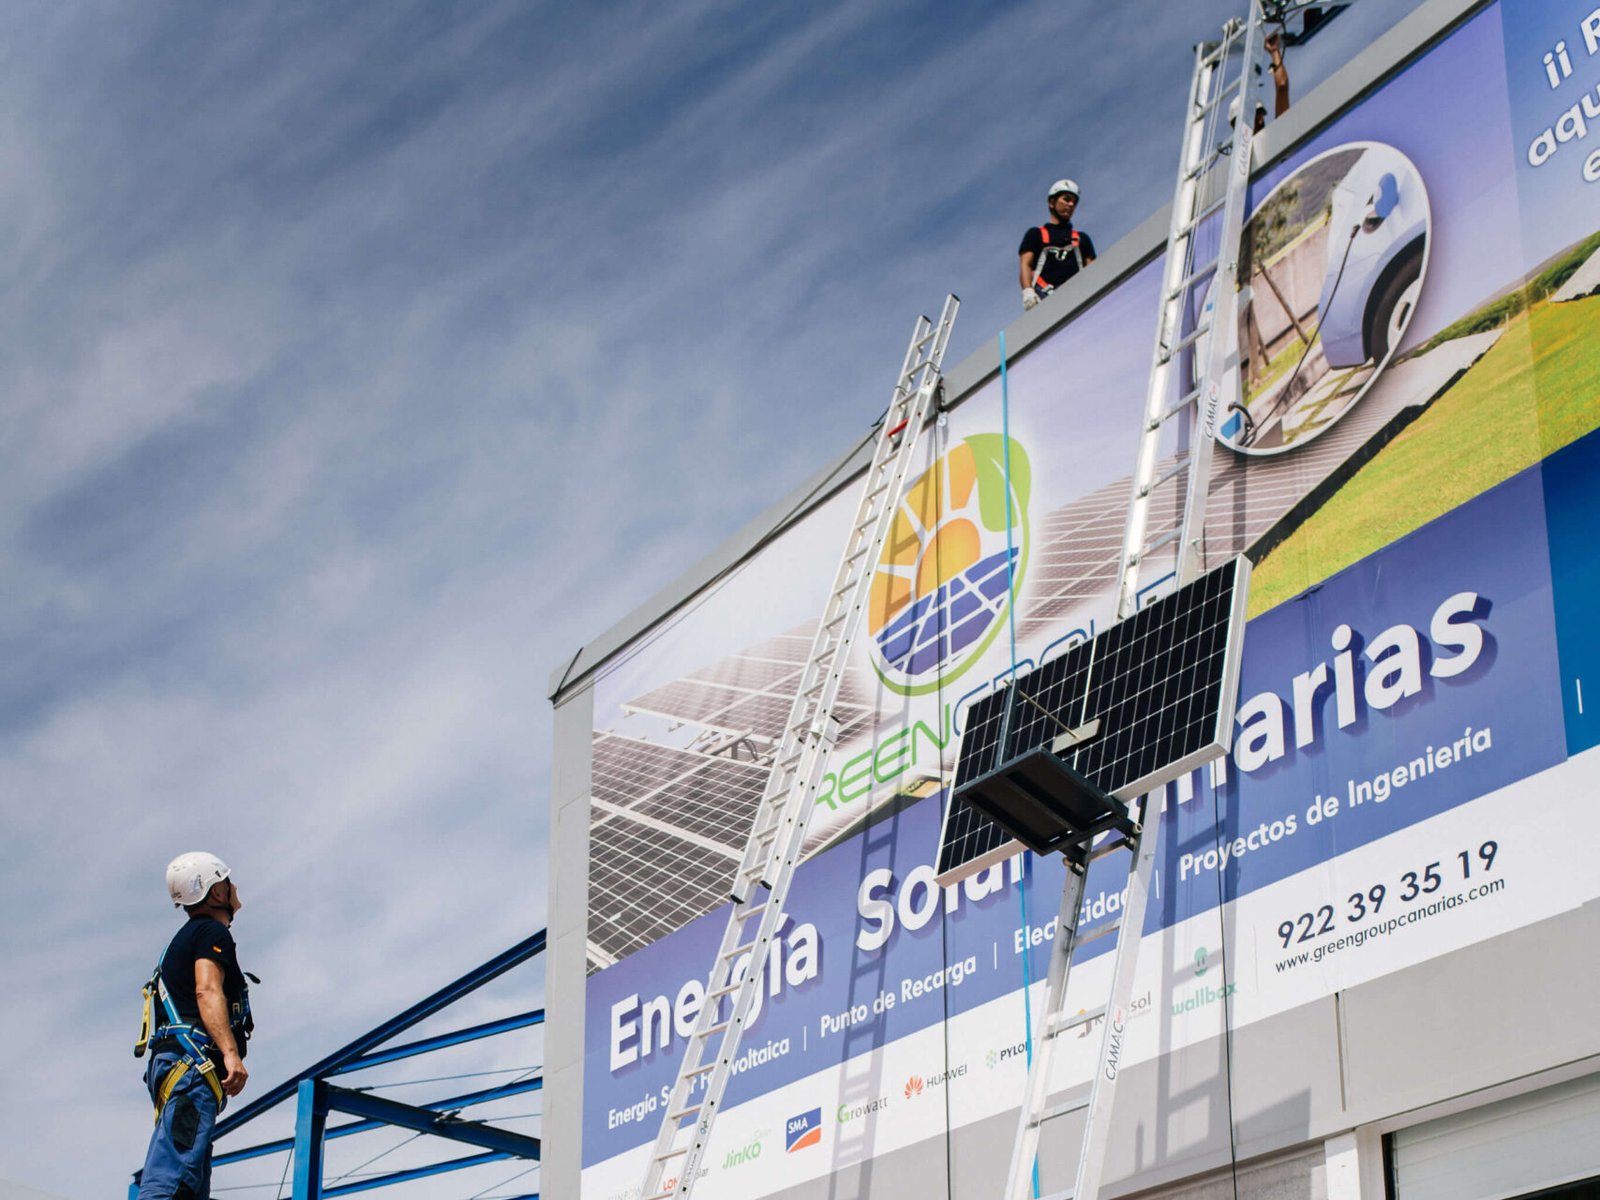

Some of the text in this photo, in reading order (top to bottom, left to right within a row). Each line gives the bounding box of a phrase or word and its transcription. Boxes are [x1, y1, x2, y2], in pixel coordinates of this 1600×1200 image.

[815, 703, 950, 811] REEN
[1180, 726, 1492, 881] Proyectos de Ingeniería
[1275, 876, 1505, 973] www.greengroupcanarias.com
[1277, 840, 1499, 949] 922 39 35 19
[820, 955, 978, 1038] Punto de Recarga
[1171, 982, 1238, 1016] wallbox
[926, 1064, 968, 1088] HUAWEI
[1105, 1020, 1123, 1081] CAMAC
[608, 1093, 657, 1130] Energía
[788, 1117, 808, 1134] SMA
[837, 1096, 888, 1124] Growatt
